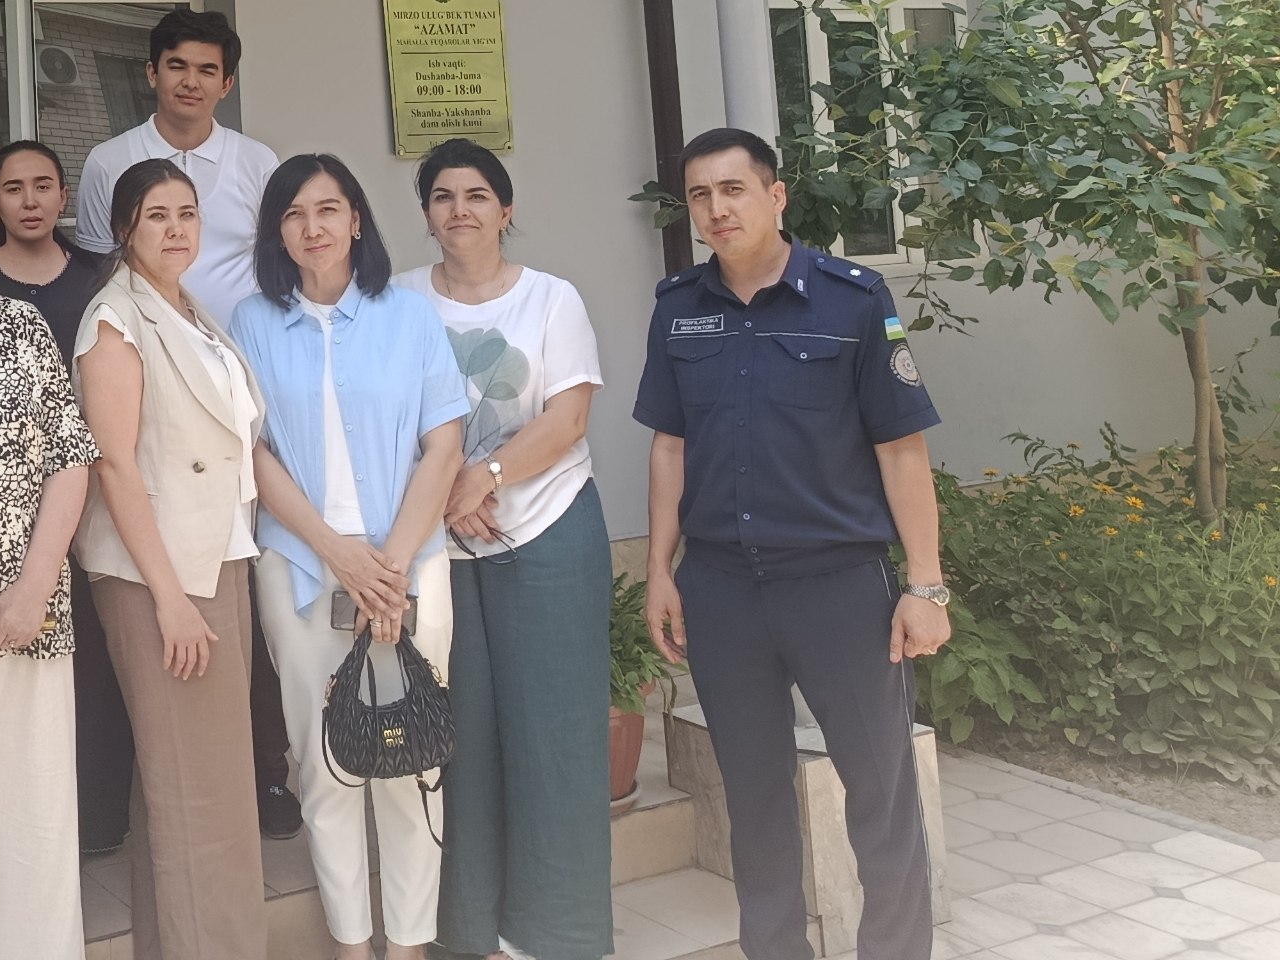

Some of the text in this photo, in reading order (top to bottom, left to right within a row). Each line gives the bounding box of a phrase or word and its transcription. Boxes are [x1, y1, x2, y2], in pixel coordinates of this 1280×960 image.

[393, 11, 420, 20] MIRZO
[464, 11, 496, 20] TUMANI
[428, 59, 467, 70] Ish vaqti:
[415, 71, 482, 81] Dushanba-Juma
[416, 84, 444, 96] 09:00
[454, 83, 482, 96] 18:00
[410, 107, 492, 118] Shanba-Yakshanba
[420, 117, 482, 129] dam olish kuni
